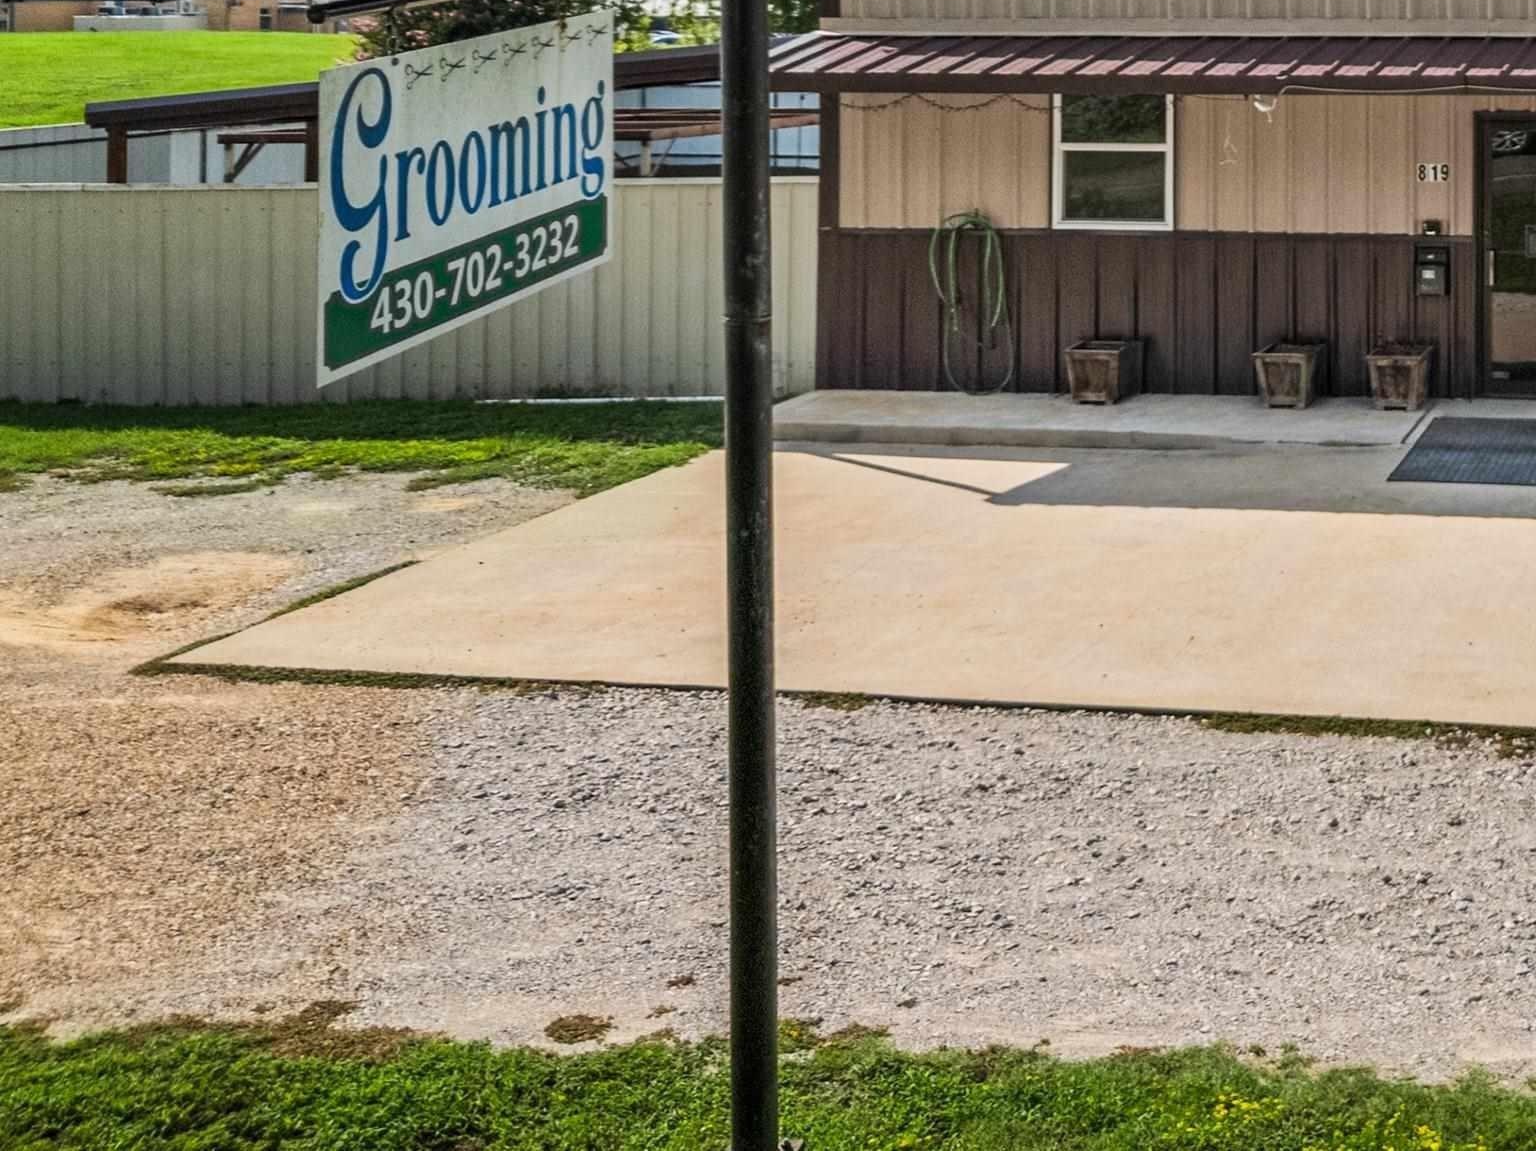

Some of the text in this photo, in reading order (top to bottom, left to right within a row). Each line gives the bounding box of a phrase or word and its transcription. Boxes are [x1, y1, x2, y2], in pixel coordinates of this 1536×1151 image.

[330, 66, 606, 302] Grooming
[1417, 164, 1449, 181] 819
[369, 213, 580, 335] 430-702-3232
